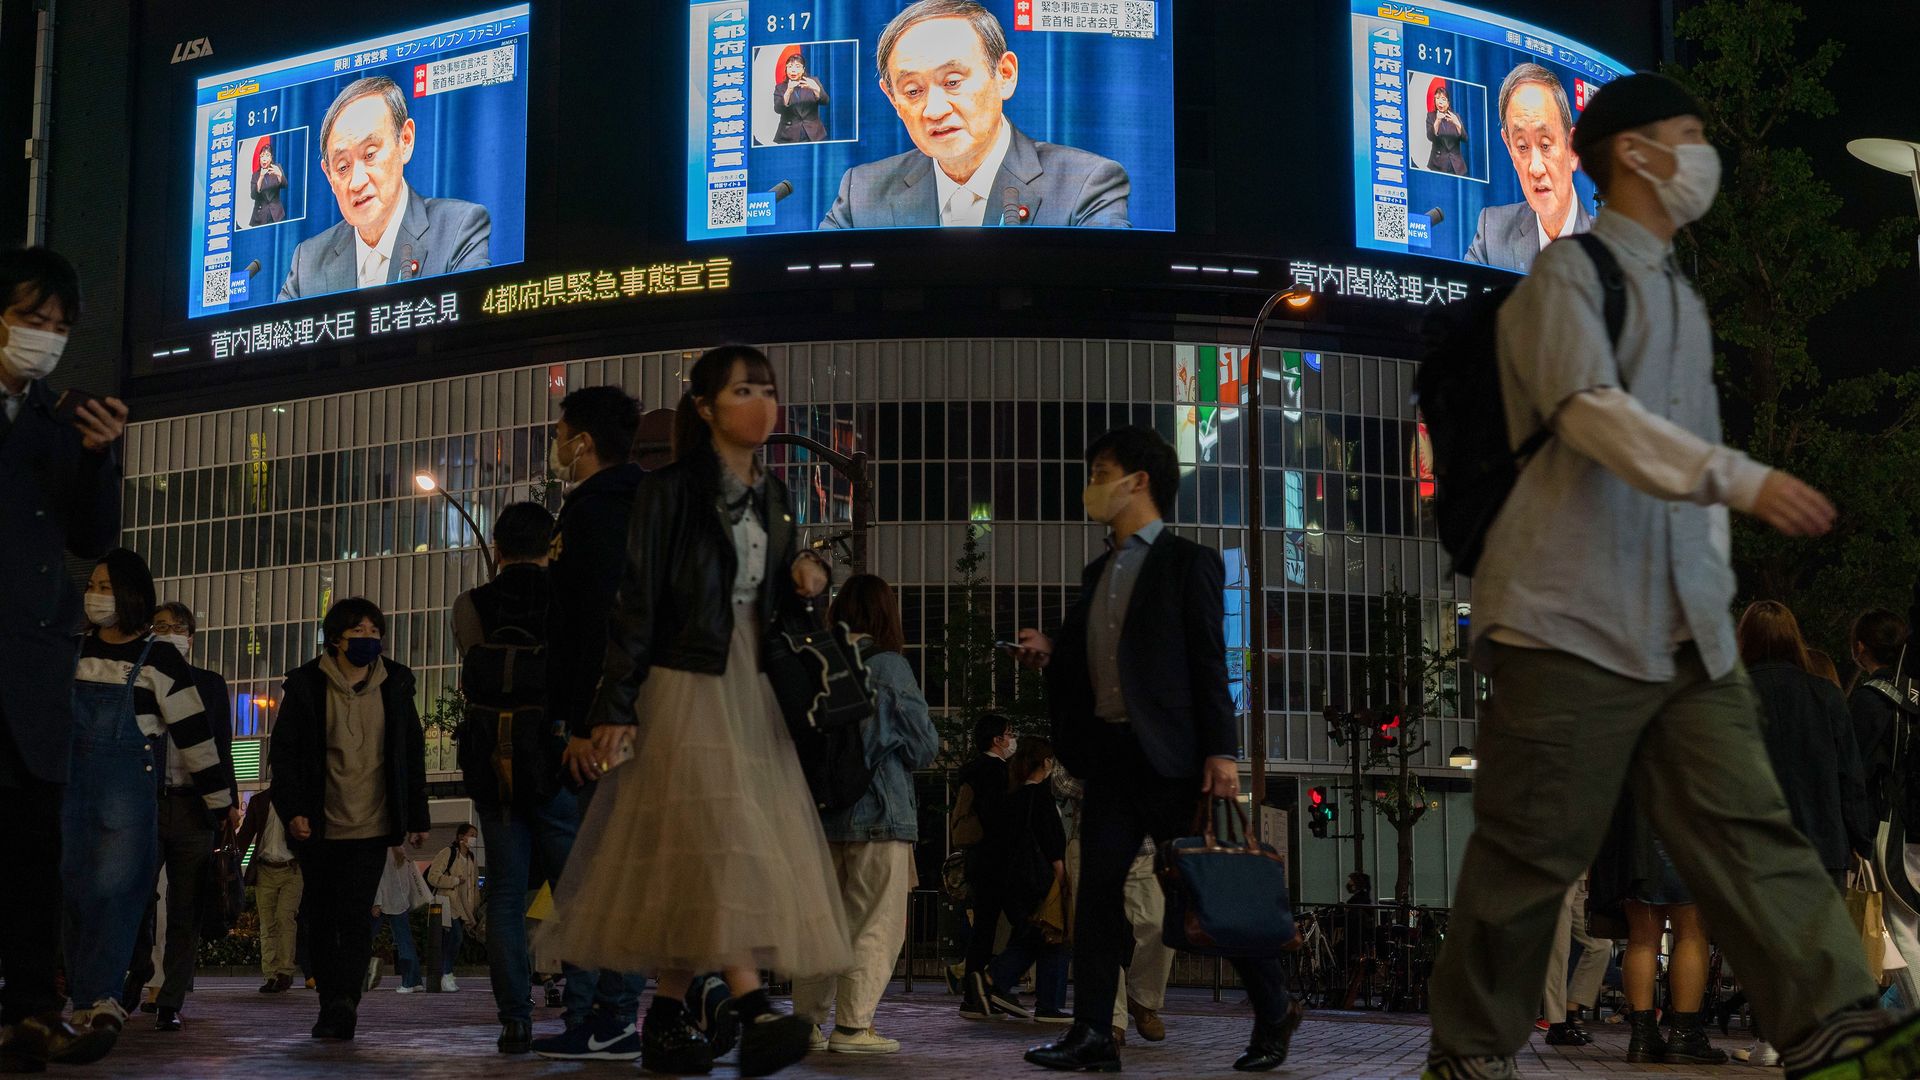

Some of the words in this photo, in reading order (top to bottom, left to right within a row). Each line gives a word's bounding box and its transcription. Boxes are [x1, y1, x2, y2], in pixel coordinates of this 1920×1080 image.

[1041, 1, 1118, 14] 緊急事態宣言決定
[1382, 1, 1425, 24] コンビニ
[767, 12, 811, 33] 8:17
[1076, 16, 1118, 29] 記者会見
[221, 78, 258, 95] コンビニ
[468, 20, 517, 42] ファミリー
[1418, 43, 1453, 66] 8:17
[248, 105, 279, 127] 8:17
[746, 209, 772, 218] NEWS
[749, 201, 769, 209] NHK
[1408, 230, 1429, 239] NEWS
[1409, 222, 1427, 231] NHK
[1290, 260, 1468, 306] 菅内閣総理大臣
[211, 310, 355, 361] 菅内閣総理大臣
[370, 292, 460, 335] 記者会見
[482, 256, 733, 315] 4都府県緊急事態宣言
